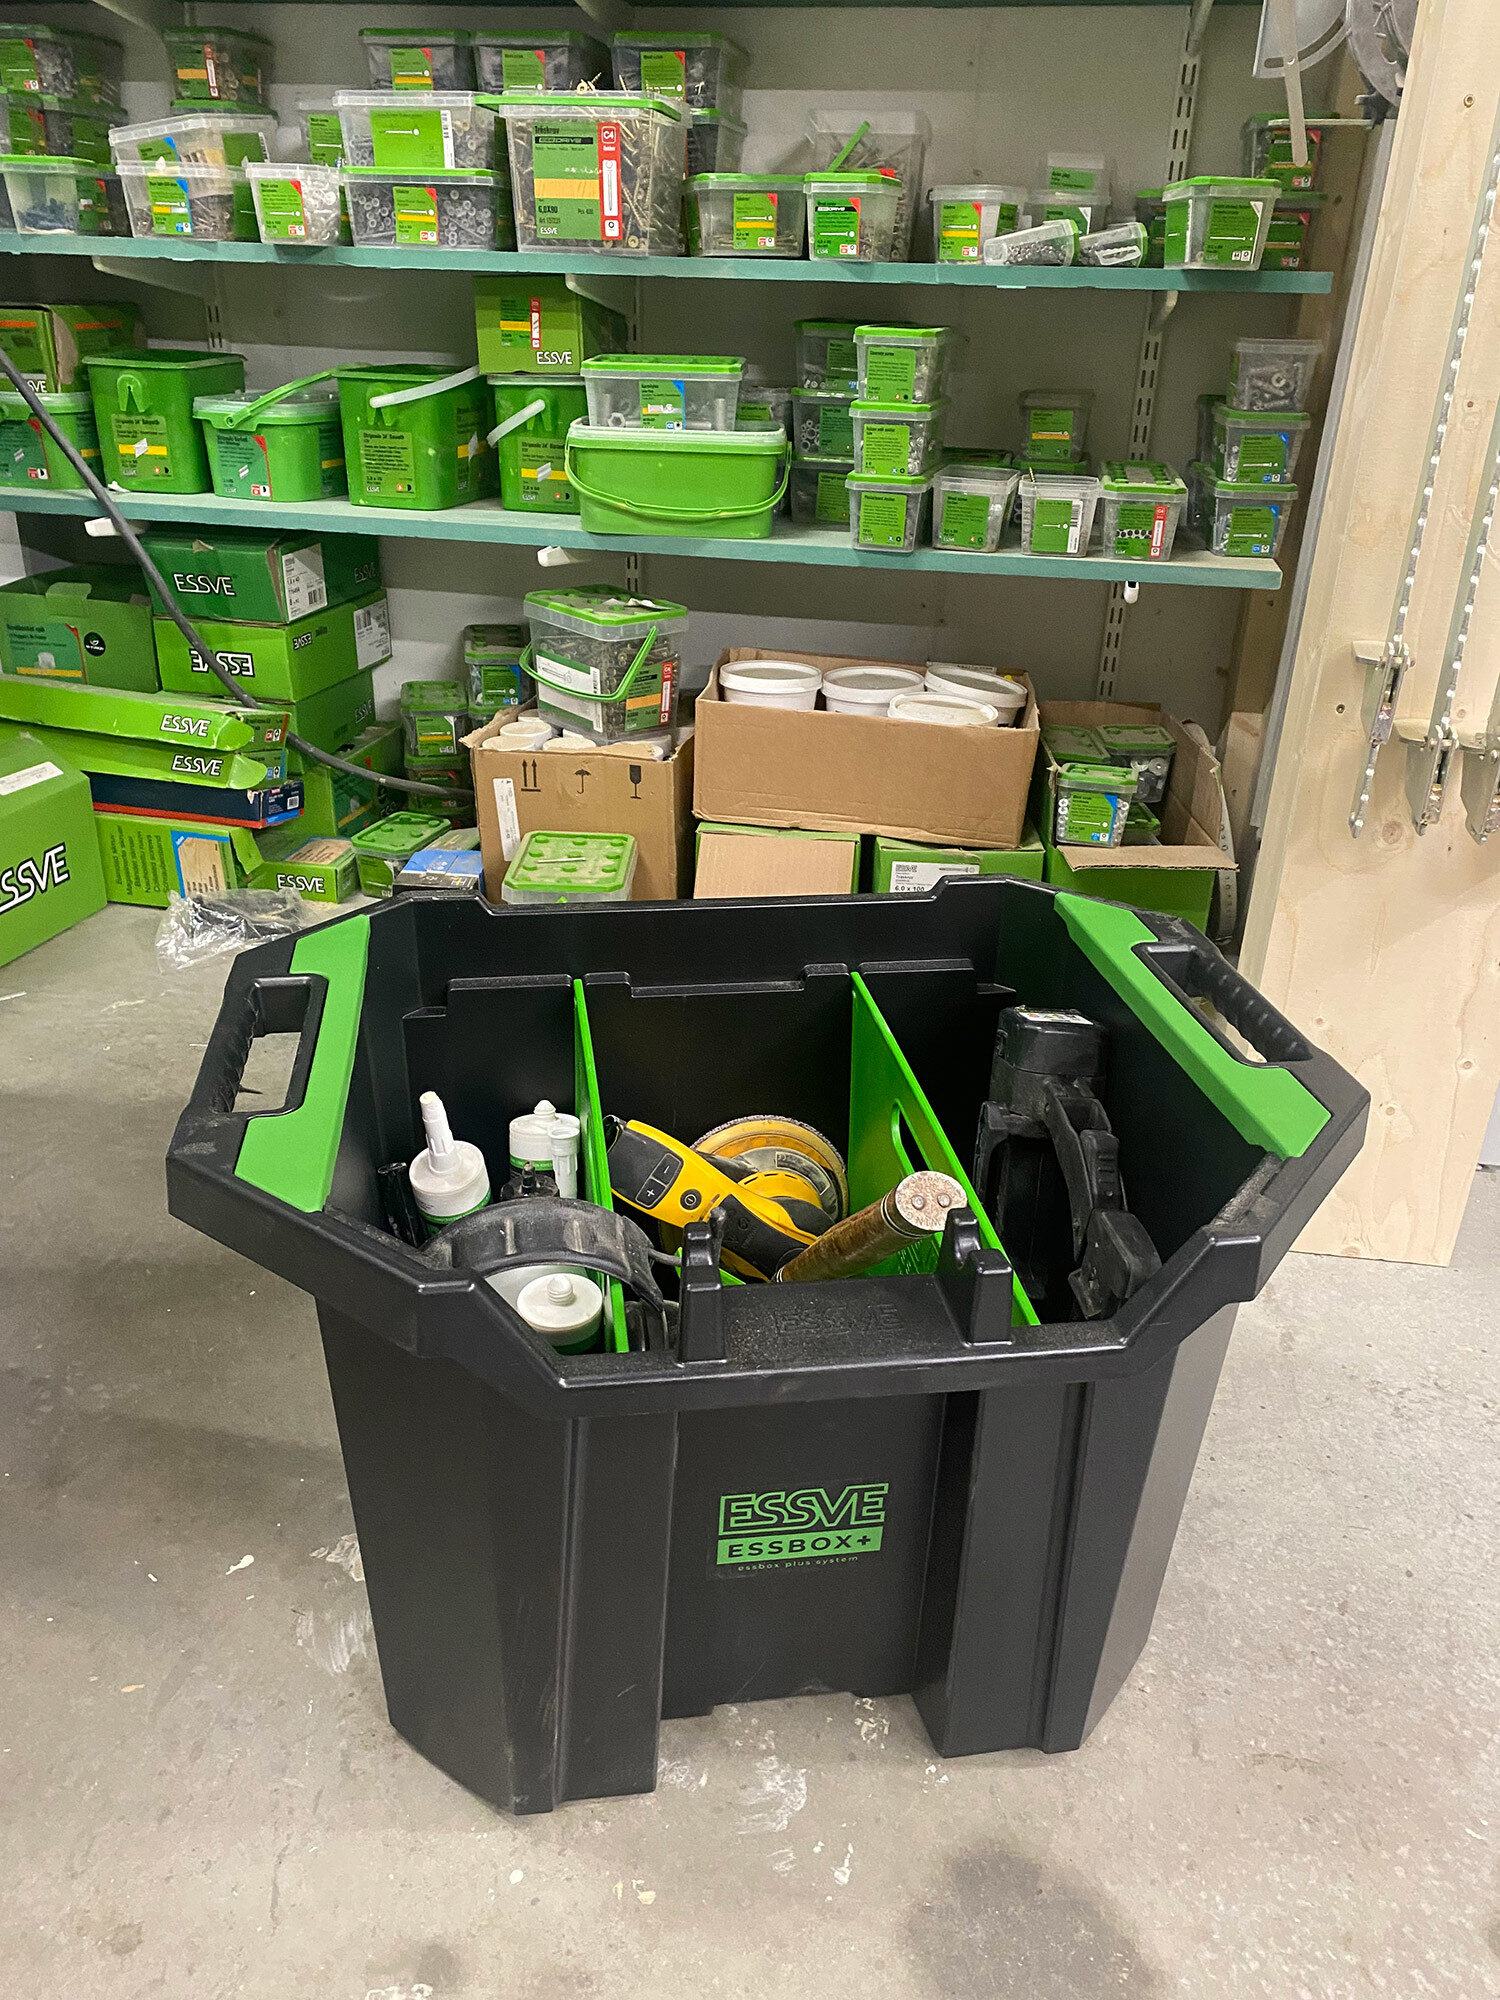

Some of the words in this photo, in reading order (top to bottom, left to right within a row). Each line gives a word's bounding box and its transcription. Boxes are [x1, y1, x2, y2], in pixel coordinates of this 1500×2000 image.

[603, 130, 615, 139] C4
[540, 227, 558, 235] ESSVE
[536, 351, 573, 365] ESSVE
[174, 573, 236, 596] ESSVE
[294, 632, 313, 650] ESSVE
[160, 714, 210, 736] ESSVE
[171, 755, 223, 776] ESSVE
[0, 841, 70, 914] SSVE
[277, 873, 326, 894] ESSVE
[718, 1482, 889, 1535] ESSVE
[728, 1534, 871, 1558] ESSBOX+
[737, 1561, 780, 1572] essbox
[785, 1559, 811, 1569] plus
[815, 1554, 859, 1566] system
